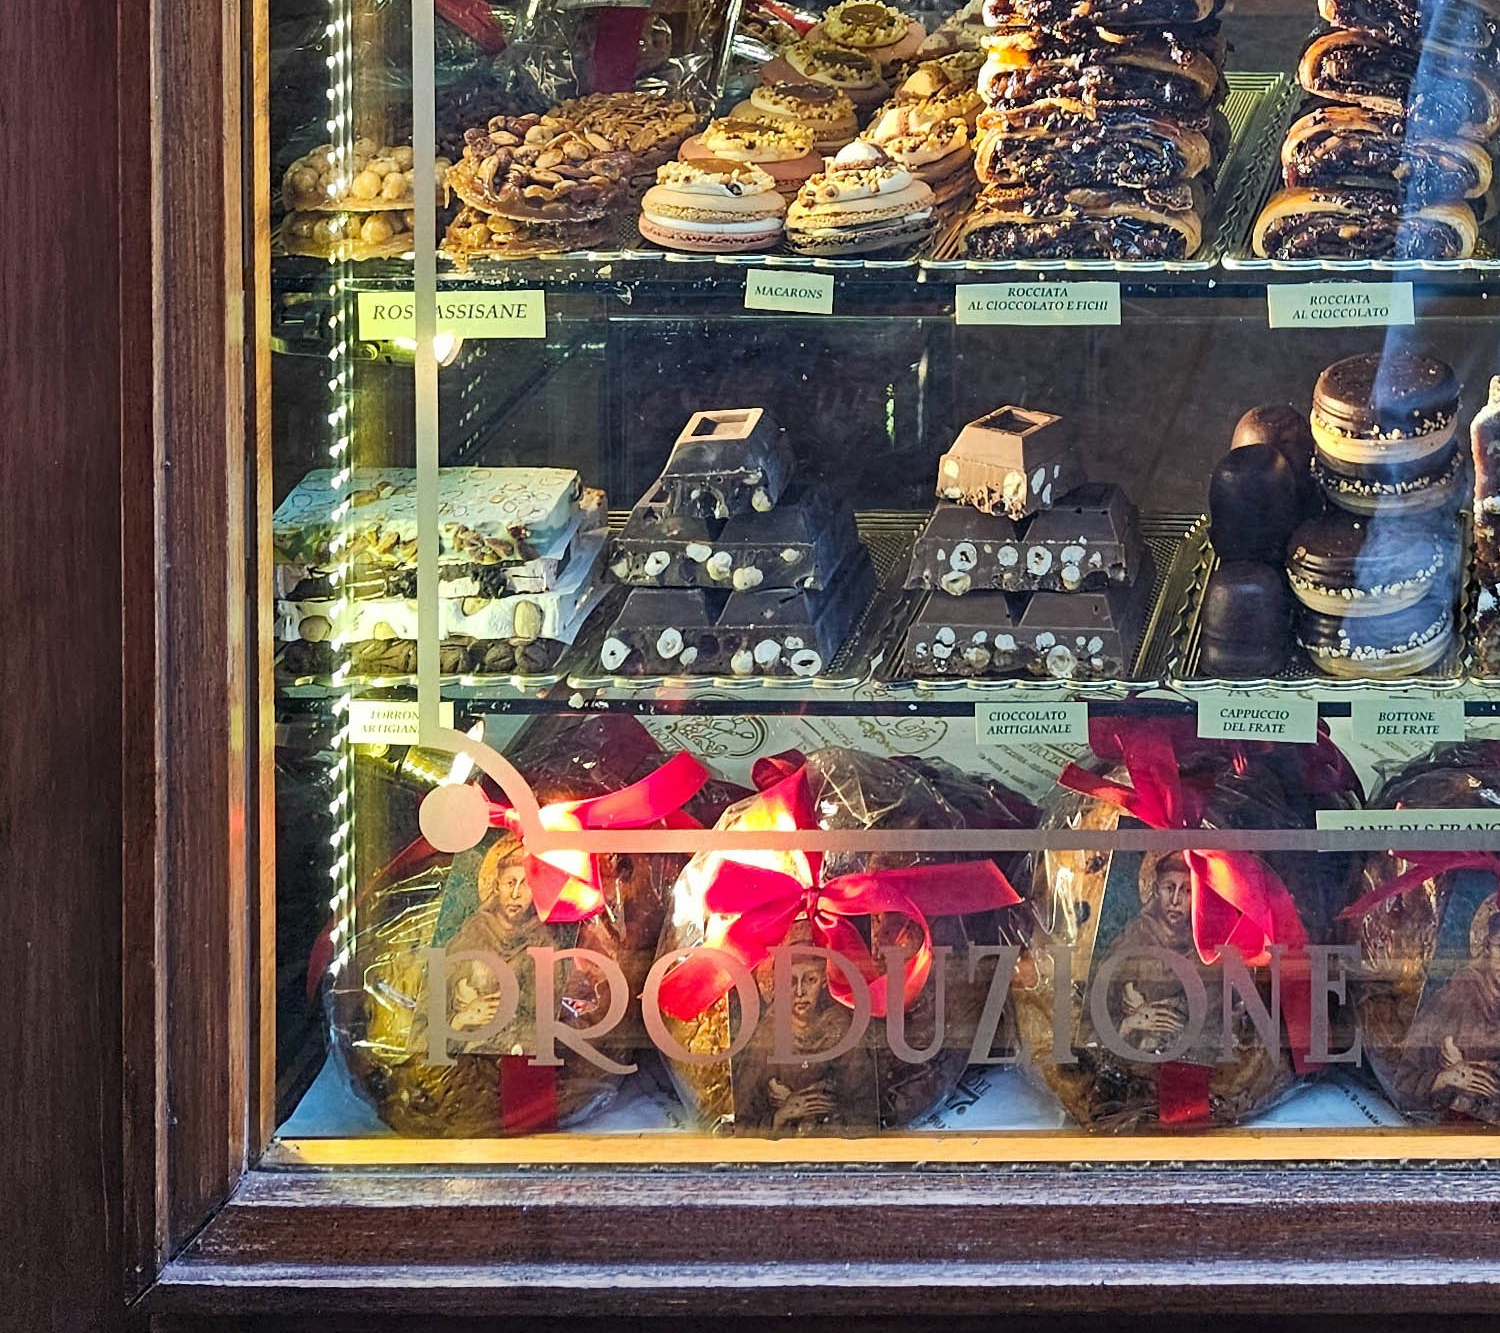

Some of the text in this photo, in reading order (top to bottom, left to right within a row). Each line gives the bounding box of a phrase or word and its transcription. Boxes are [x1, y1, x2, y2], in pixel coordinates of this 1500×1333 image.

[755, 285, 823, 300] MACARONS
[1007, 286, 1069, 298] ROCCIATA
[968, 299, 1109, 311] AL CIOCCOLATO E FICHI
[1309, 294, 1371, 306] ROCCIATA
[373, 304, 415, 321] ROS
[1292, 307, 1390, 320] AL CIOCCOLATO
[370, 709, 421, 720] TORRON
[988, 710, 1067, 722] CIOCCOLATO
[1219, 708, 1290, 721] CAPPUCCIO
[1378, 711, 1436, 722] BOTTONE
[1223, 722, 1286, 735] DEL FRATE
[1376, 724, 1440, 735] DEL FRATE
[425, 942, 1363, 1072] PRODUZIONE
